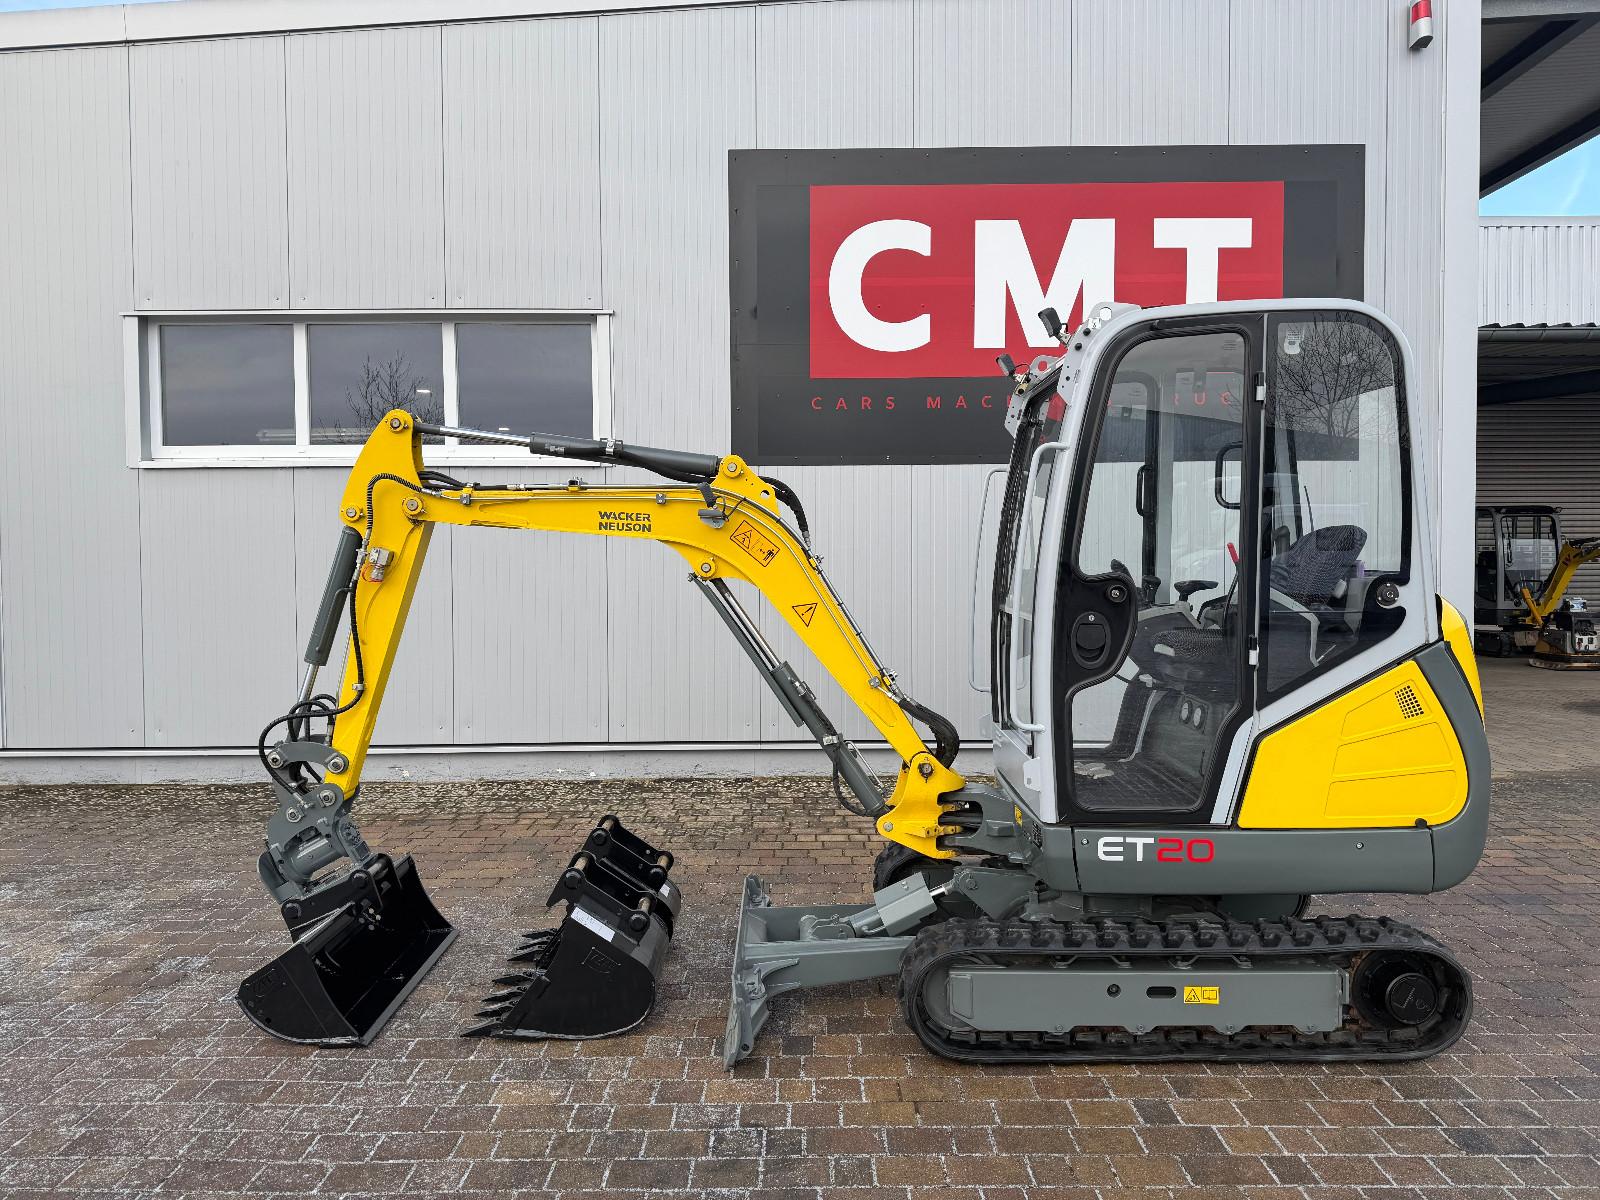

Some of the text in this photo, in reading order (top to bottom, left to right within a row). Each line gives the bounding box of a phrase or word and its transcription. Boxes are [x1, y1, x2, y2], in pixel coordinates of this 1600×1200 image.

[828, 217, 1253, 352] CMT
[811, 396, 895, 410] CARS
[598, 510, 652, 522] WACKER
[598, 521, 652, 533] NEUSON
[1097, 836, 1215, 863] ET20
